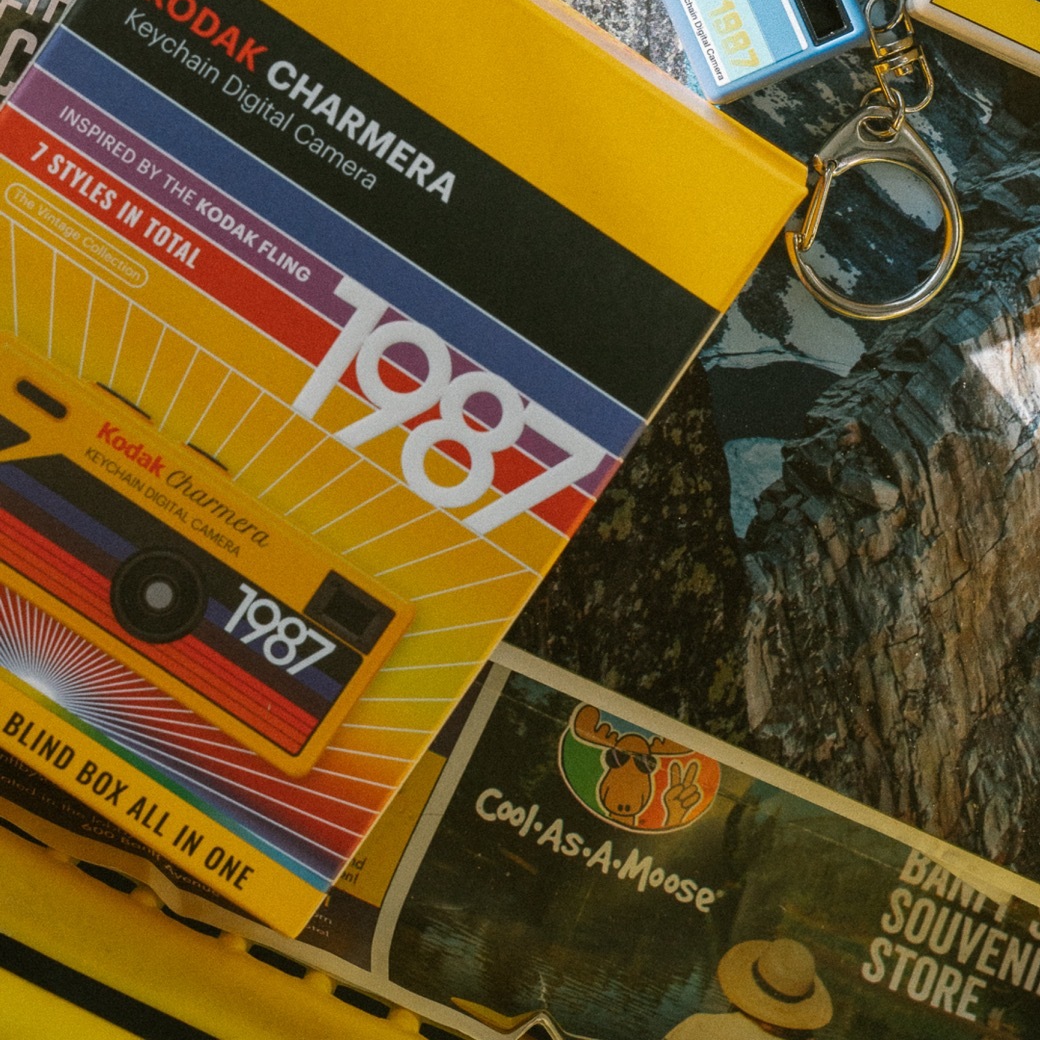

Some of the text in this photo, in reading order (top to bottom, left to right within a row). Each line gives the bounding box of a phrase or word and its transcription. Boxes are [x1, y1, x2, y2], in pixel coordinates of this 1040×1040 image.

[124, 8, 377, 191] Keychain Digital Camera
[694, 20, 711, 49] Digital
[706, 48, 725, 81] Camera
[59, 105, 312, 283] INSPIRED BY THE KODAK FLING
[267, 60, 456, 203] CHARMERA
[14, 189, 141, 281] The Vintage Collection
[30, 142, 202, 270] 7 STYLES IN TOTAL
[292, 275, 607, 536] 1987
[84, 446, 240, 558] KEYCHAIN DIGITAL CAMERA
[97, 421, 271, 549] Kodak Charmera
[223, 582, 337, 676] 1987
[2, 711, 76, 770] BLIND
[75, 759, 129, 806] BOX
[126, 796, 170, 837] ALL
[172, 824, 205, 857] IN
[203, 846, 255, 891] ONE
[861, 936, 988, 1022] STORE
